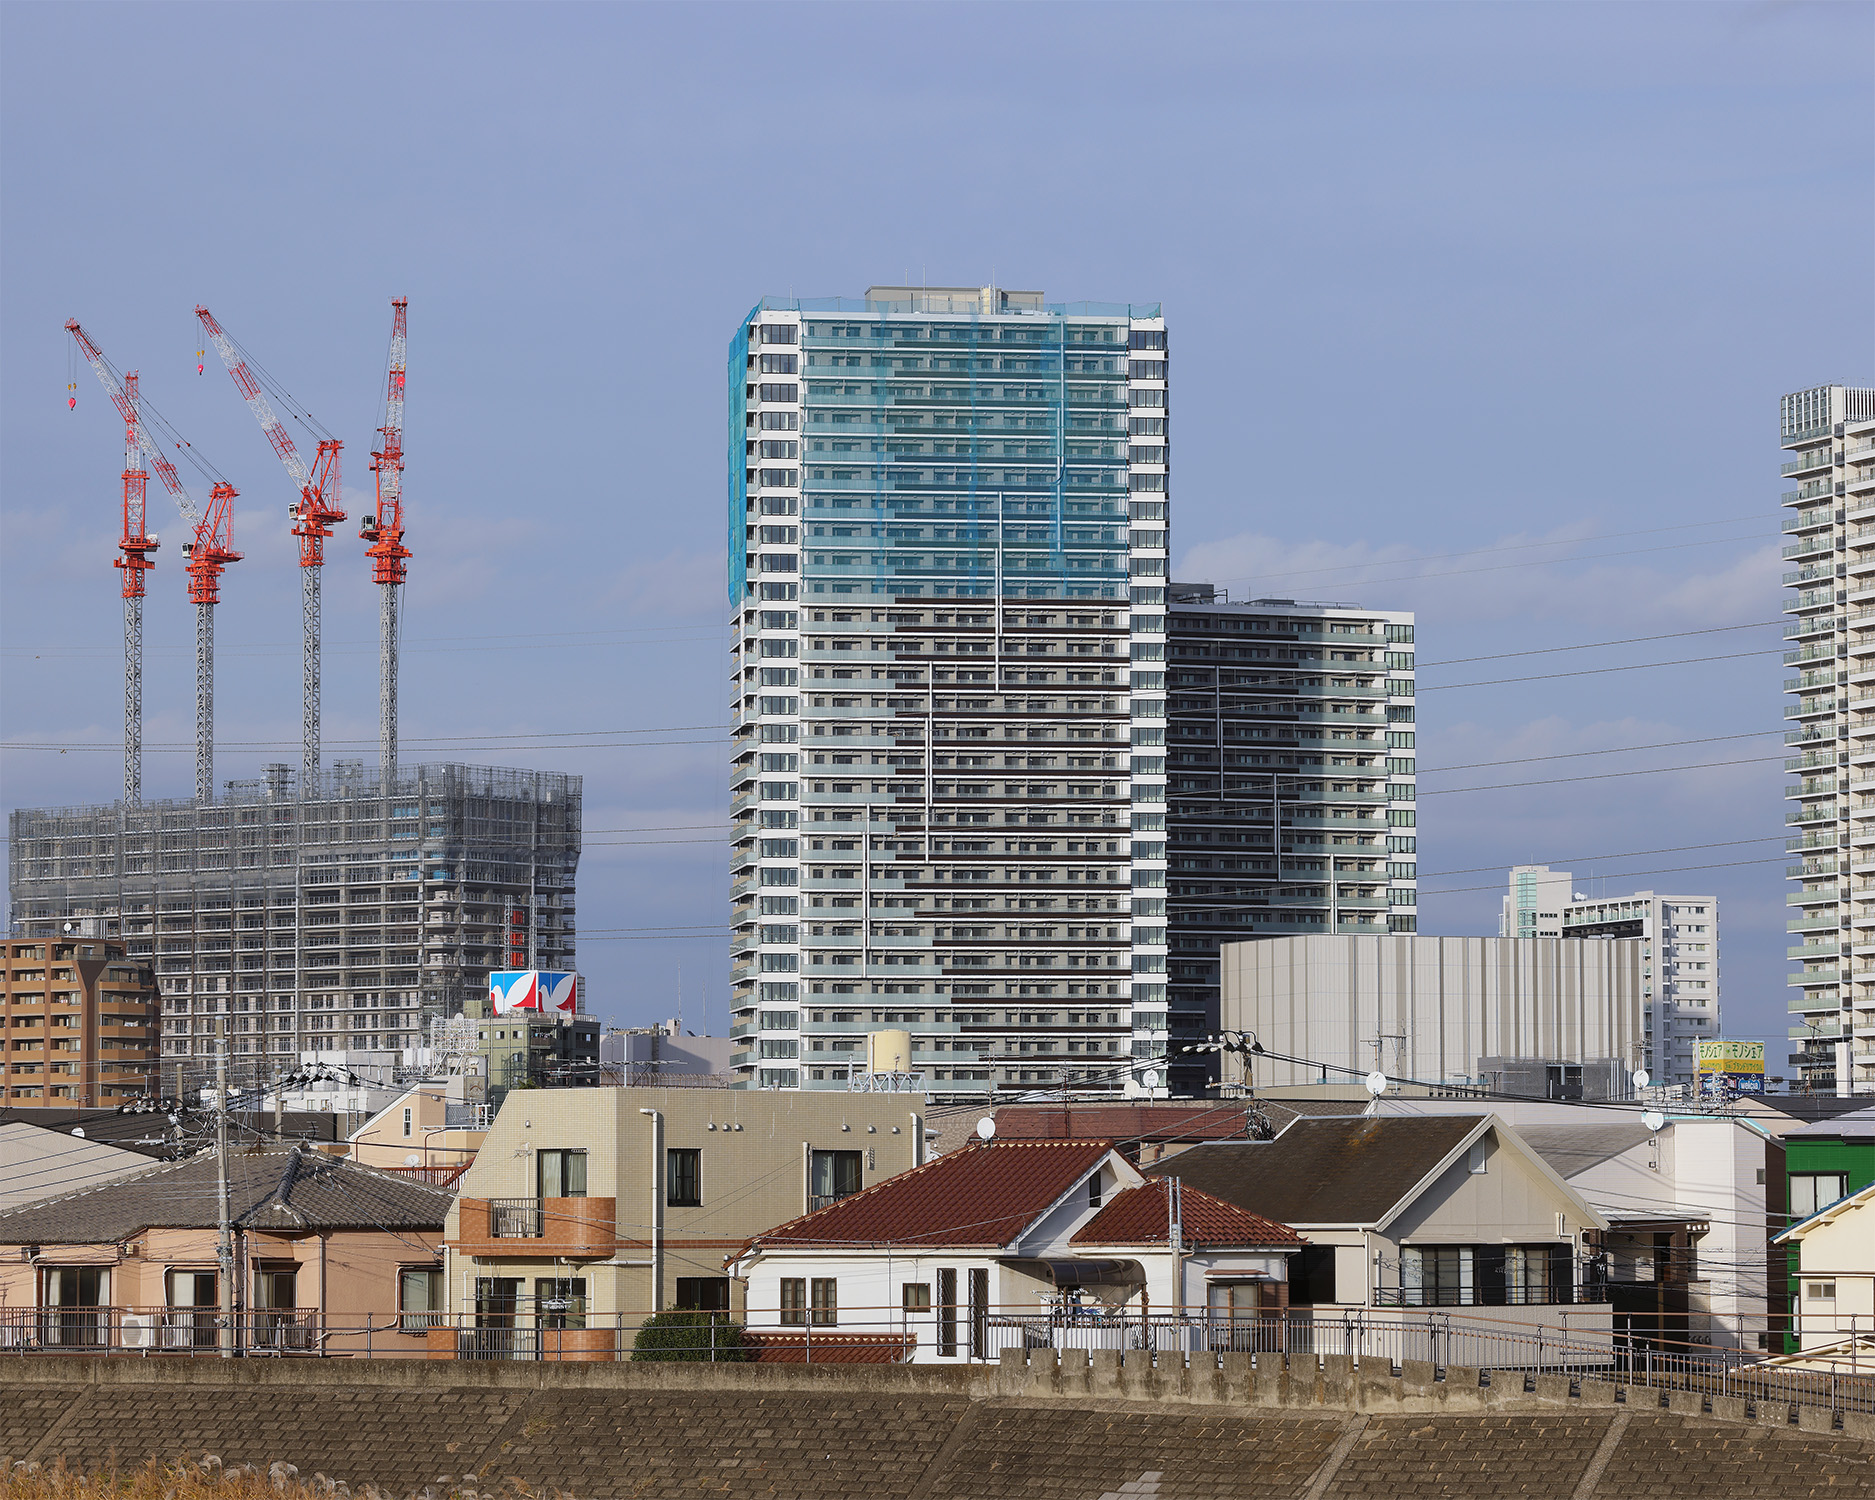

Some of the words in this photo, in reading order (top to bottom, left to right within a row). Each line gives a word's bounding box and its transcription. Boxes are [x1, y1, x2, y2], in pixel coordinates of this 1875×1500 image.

[1732, 1044, 1763, 1059] モノシェア
